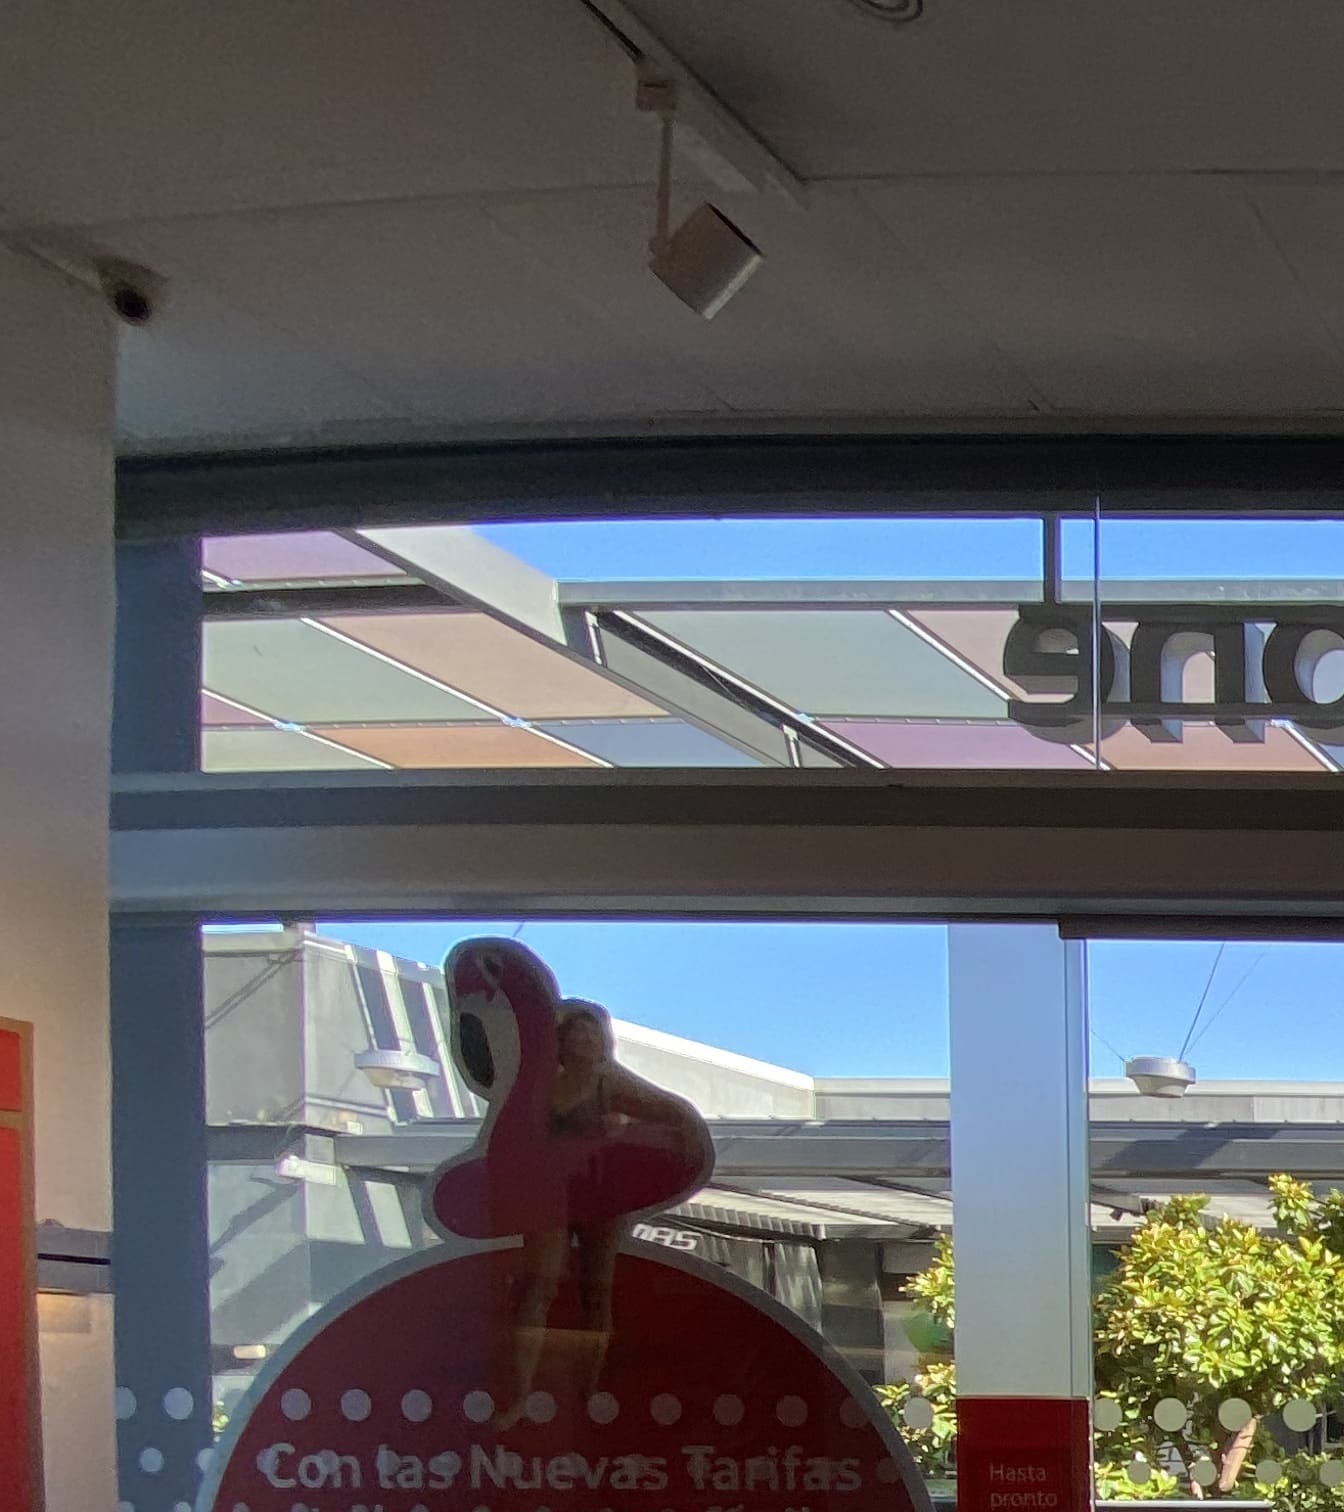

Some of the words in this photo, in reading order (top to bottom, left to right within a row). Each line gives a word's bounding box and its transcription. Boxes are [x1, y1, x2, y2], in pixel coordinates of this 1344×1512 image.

[264, 1443, 361, 1489] Con
[376, 1443, 463, 1489] las
[469, 1444, 669, 1490] Nuevas
[681, 1444, 862, 1491] Tarifas
[990, 1464, 1047, 1482] Hasta
[990, 1490, 1058, 1510] pronto
